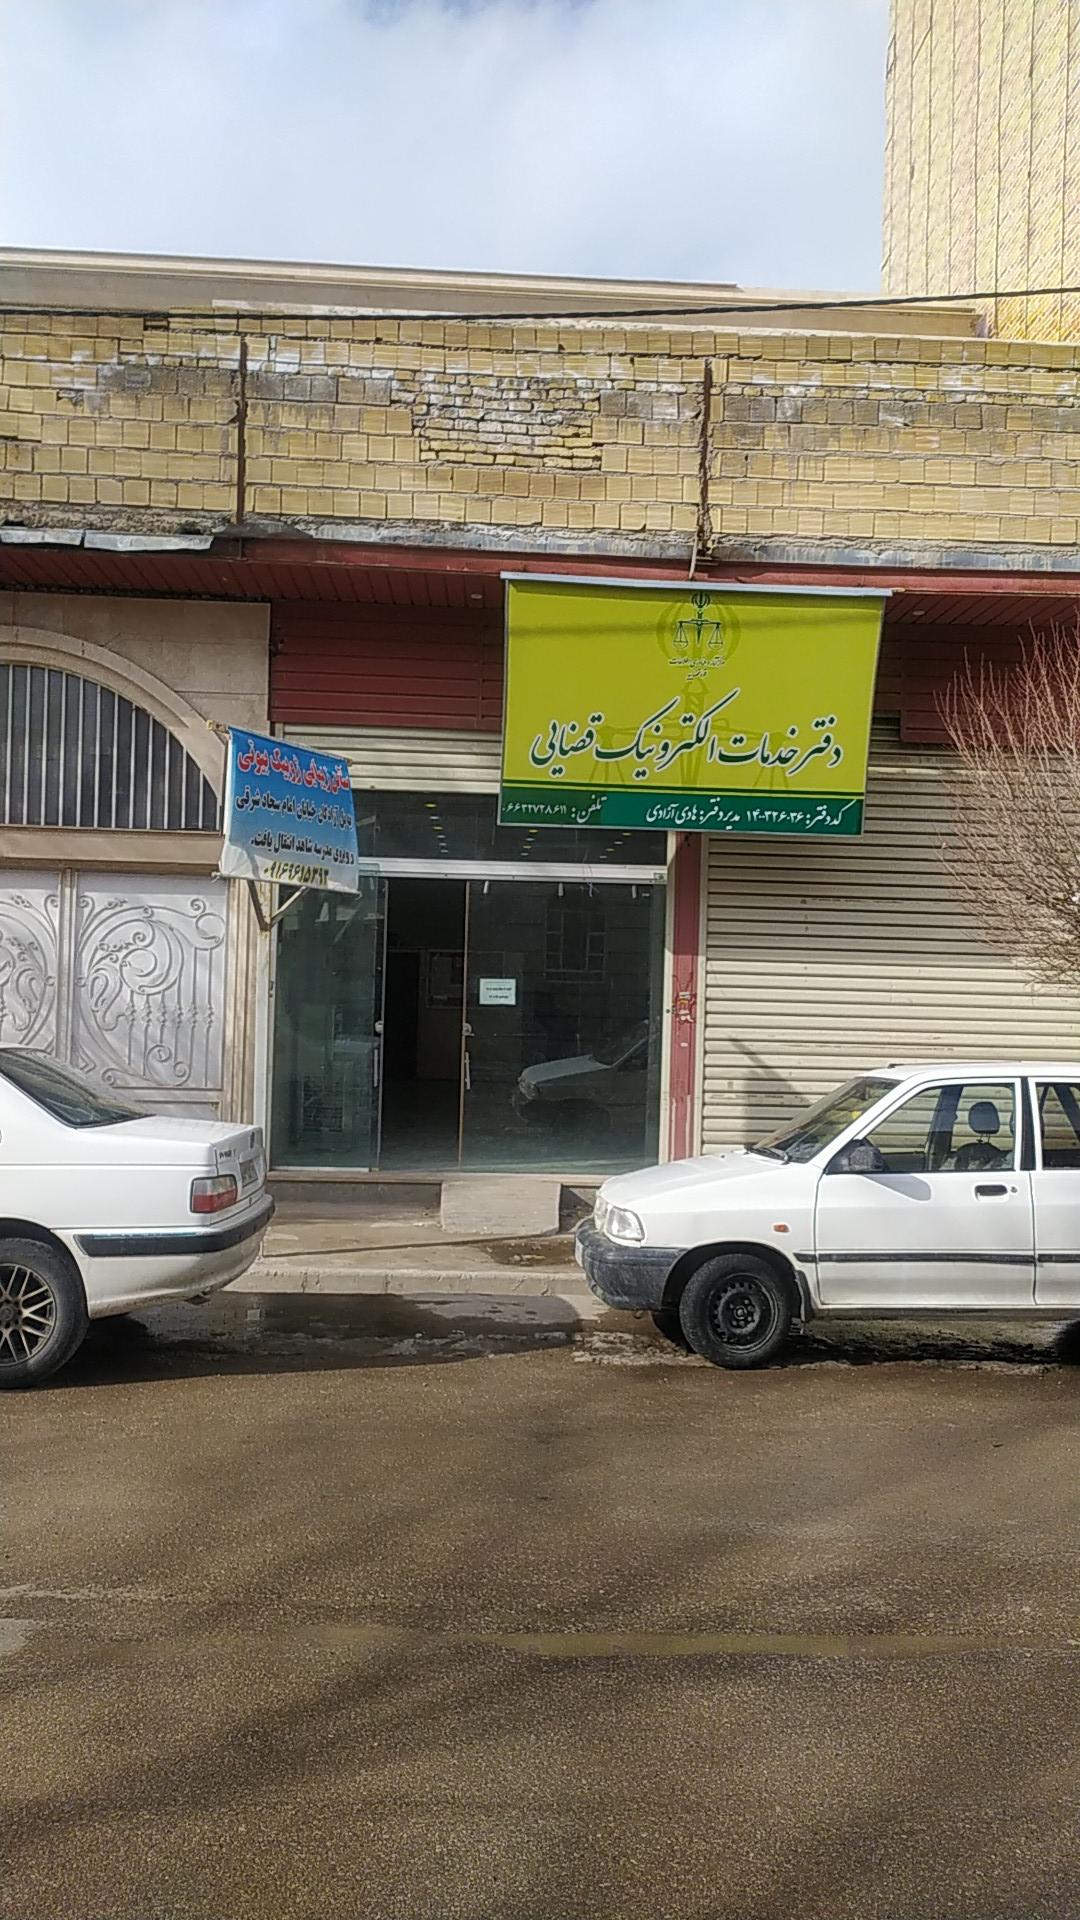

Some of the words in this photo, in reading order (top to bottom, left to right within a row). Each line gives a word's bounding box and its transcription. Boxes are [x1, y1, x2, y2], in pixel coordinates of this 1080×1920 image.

[529, 711, 603, 778] قضایی
[594, 688, 740, 780] الکترونیک
[718, 726, 799, 767] خدمات
[787, 713, 843, 777] دفتر
[235, 784, 261, 811] شرقی
[262, 790, 281, 815] سجاد
[281, 794, 296, 817] امام
[296, 798, 317, 821] خیابان
[646, 803, 679, 823] آزادی
[676, 804, 698, 825] هادی
[723, 809, 741, 830] مدیر
[830, 799, 857, 826] کد
